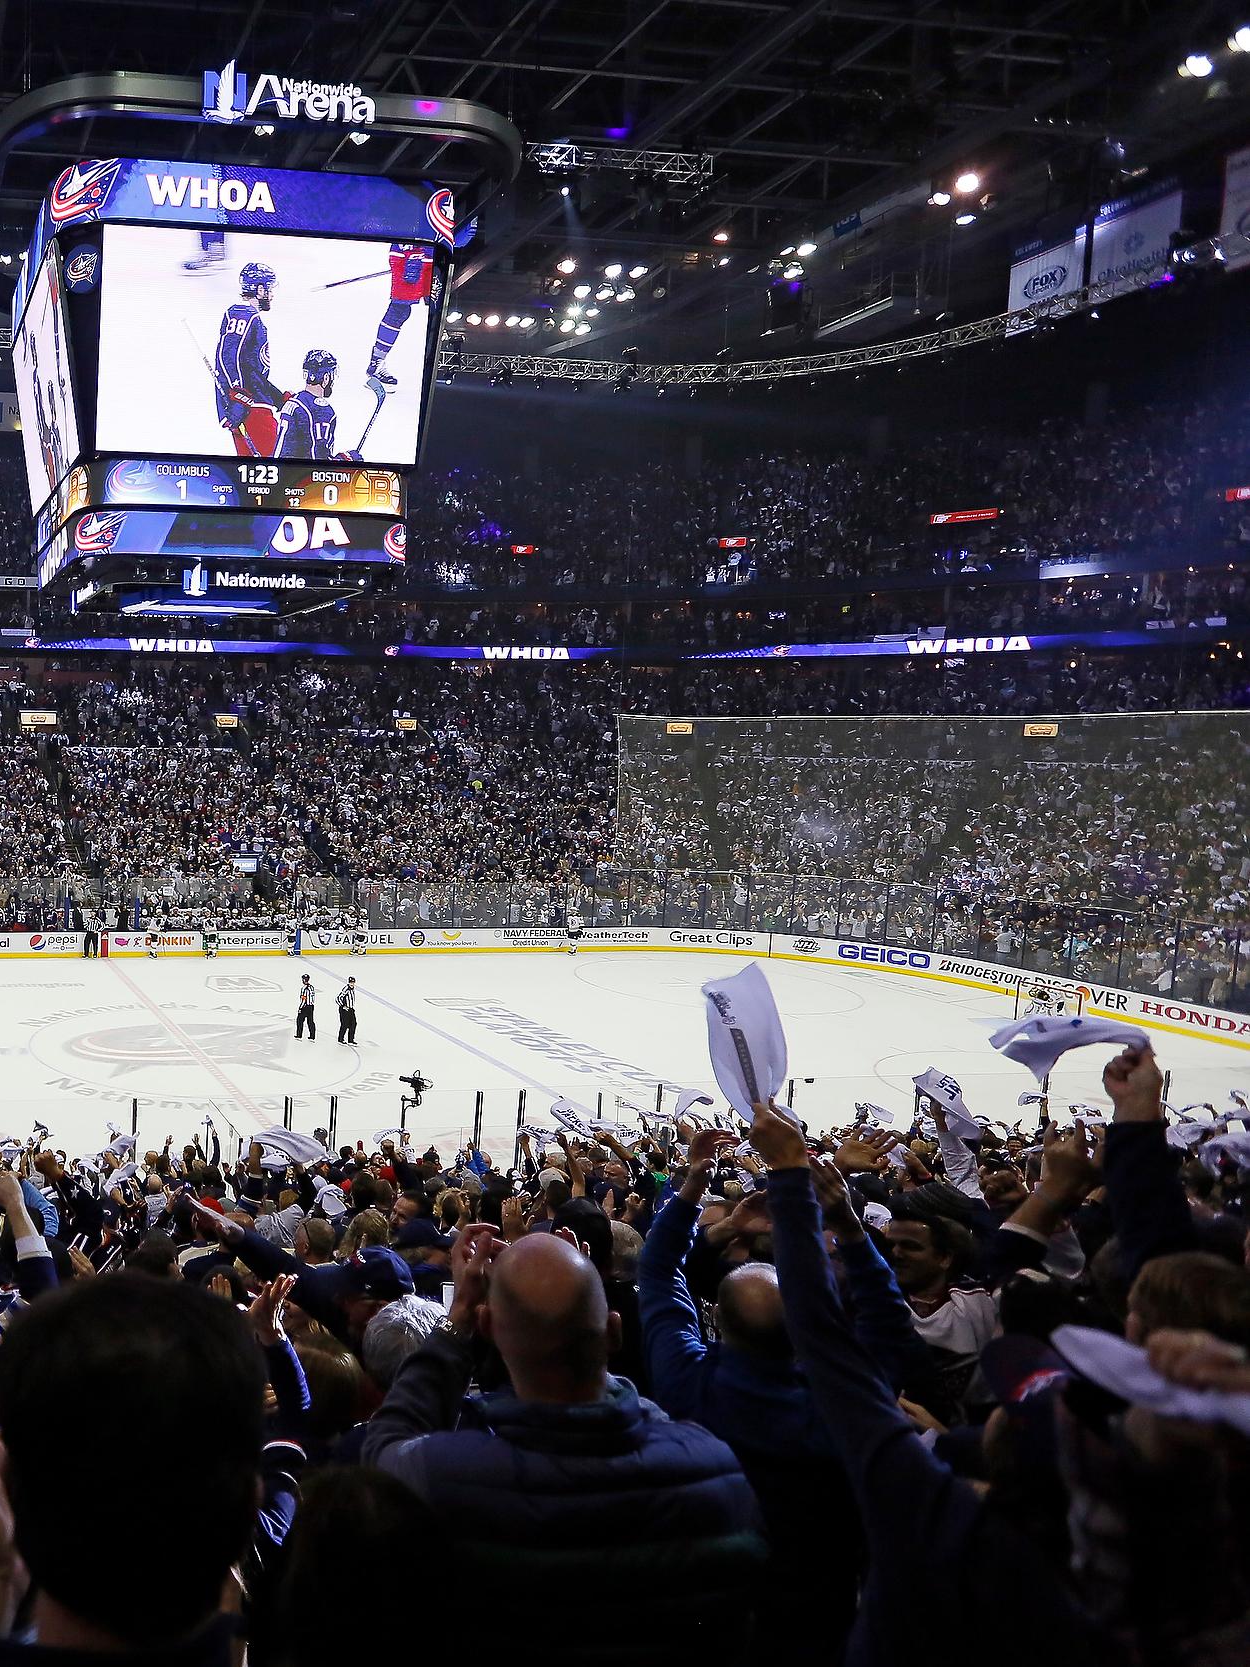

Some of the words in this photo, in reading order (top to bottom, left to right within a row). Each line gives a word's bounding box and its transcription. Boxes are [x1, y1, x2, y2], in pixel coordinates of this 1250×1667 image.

[282, 77, 362, 98] Nationwide
[244, 74, 377, 125] Arena
[146, 173, 275, 214] WHOA
[1032, 270, 1058, 291] FOX
[227, 318, 247, 335] 38
[315, 422, 331, 440] 17
[156, 465, 210, 478] COLUMBUS
[237, 464, 279, 485] 1:23
[312, 471, 351, 484] BOSTON
[176, 480, 188, 500] 1
[212, 485, 233, 494] SHOTS
[248, 486, 270, 496] PERIOD
[284, 487, 305, 497] SHOTS
[323, 484, 338, 506] 0
[255, 495, 263, 506] 1
[287, 497, 300, 507] 12
[4, 578, 26, 586] GO
[215, 571, 305, 590] Nationwide
[128, 637, 215, 652] WHOA
[482, 646, 570, 659] WHOA
[906, 635, 1032, 655] WHOA
[47, 934, 78, 947] pepsi
[216, 935, 280, 947] nterprise
[503, 929, 528, 938] NAVY
[529, 929, 566, 938] FEDERAL
[670, 930, 713, 944] Great
[716, 932, 754, 948] Clips
[838, 944, 931, 969] GEICO
